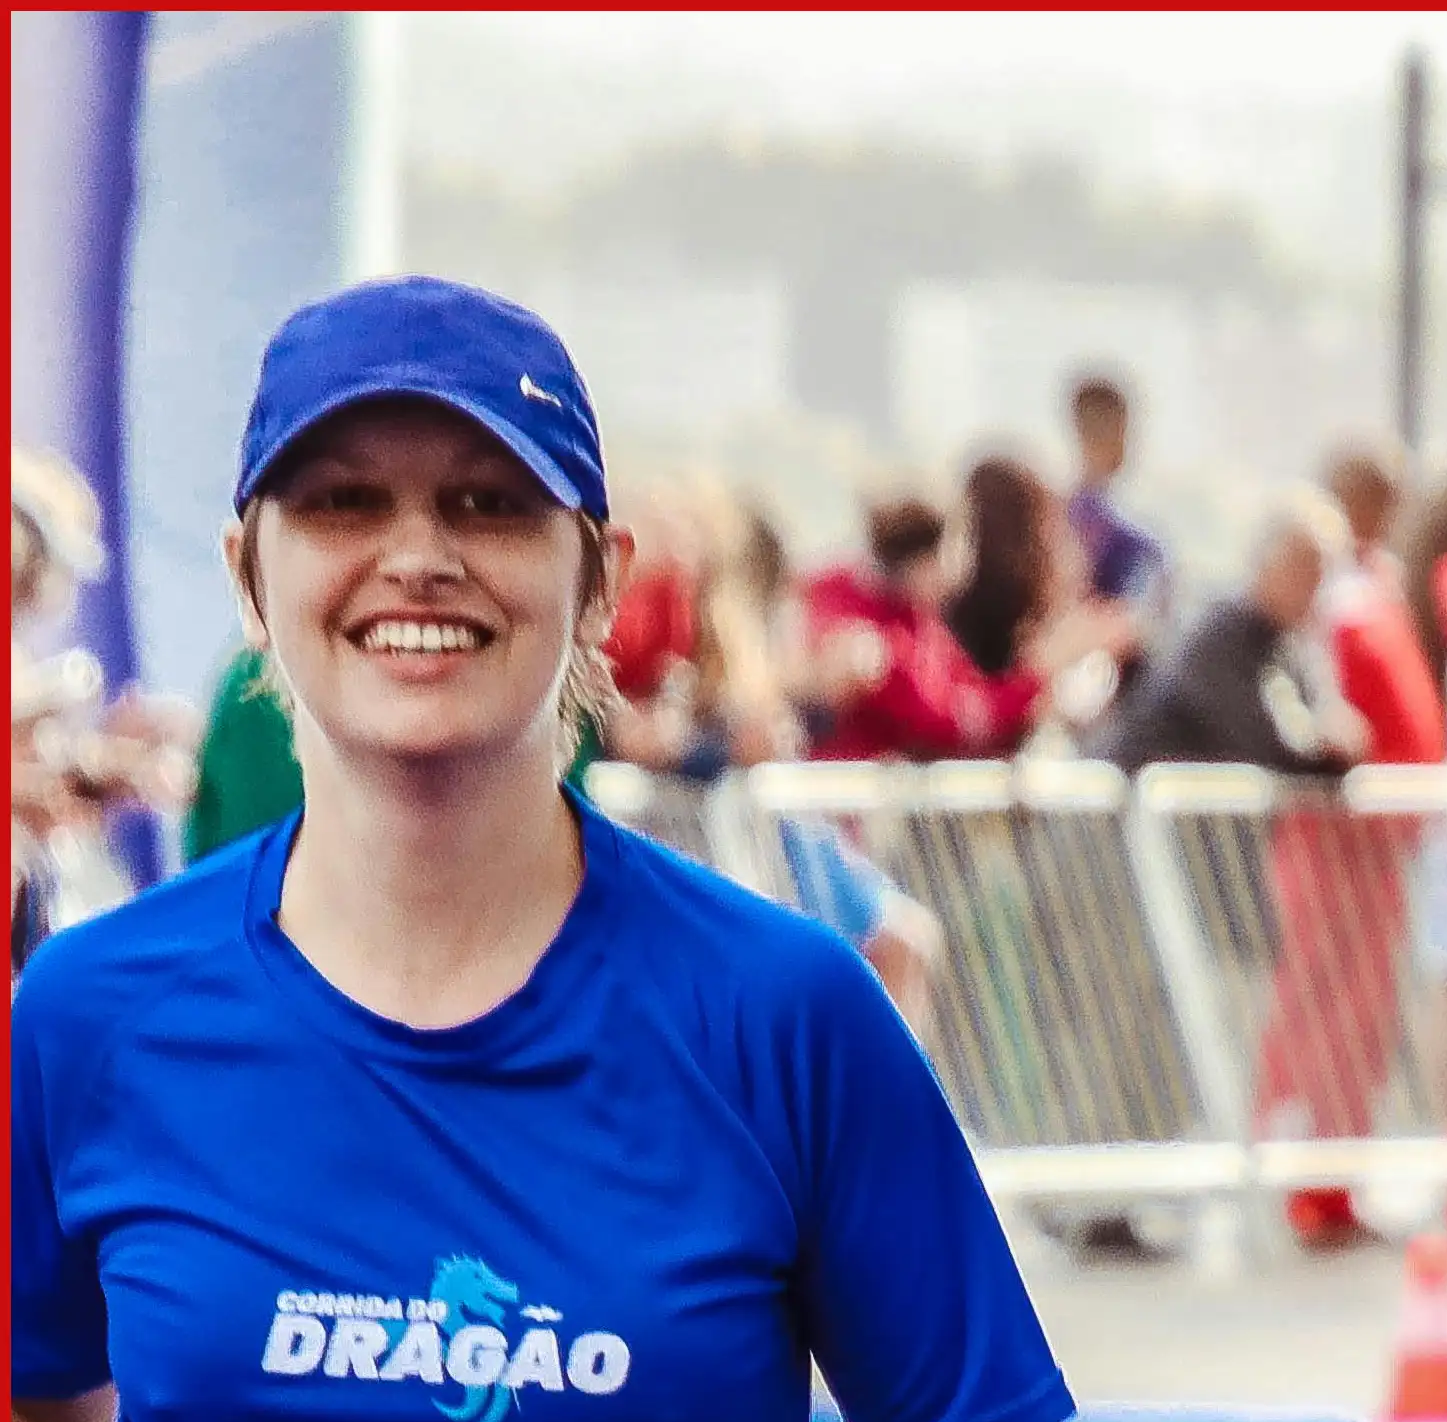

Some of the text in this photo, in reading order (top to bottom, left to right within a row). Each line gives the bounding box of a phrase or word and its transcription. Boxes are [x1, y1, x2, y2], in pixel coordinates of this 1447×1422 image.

[276, 1289, 448, 1323] CORRIDA DO
[261, 1305, 631, 1394] DRAGÃO
